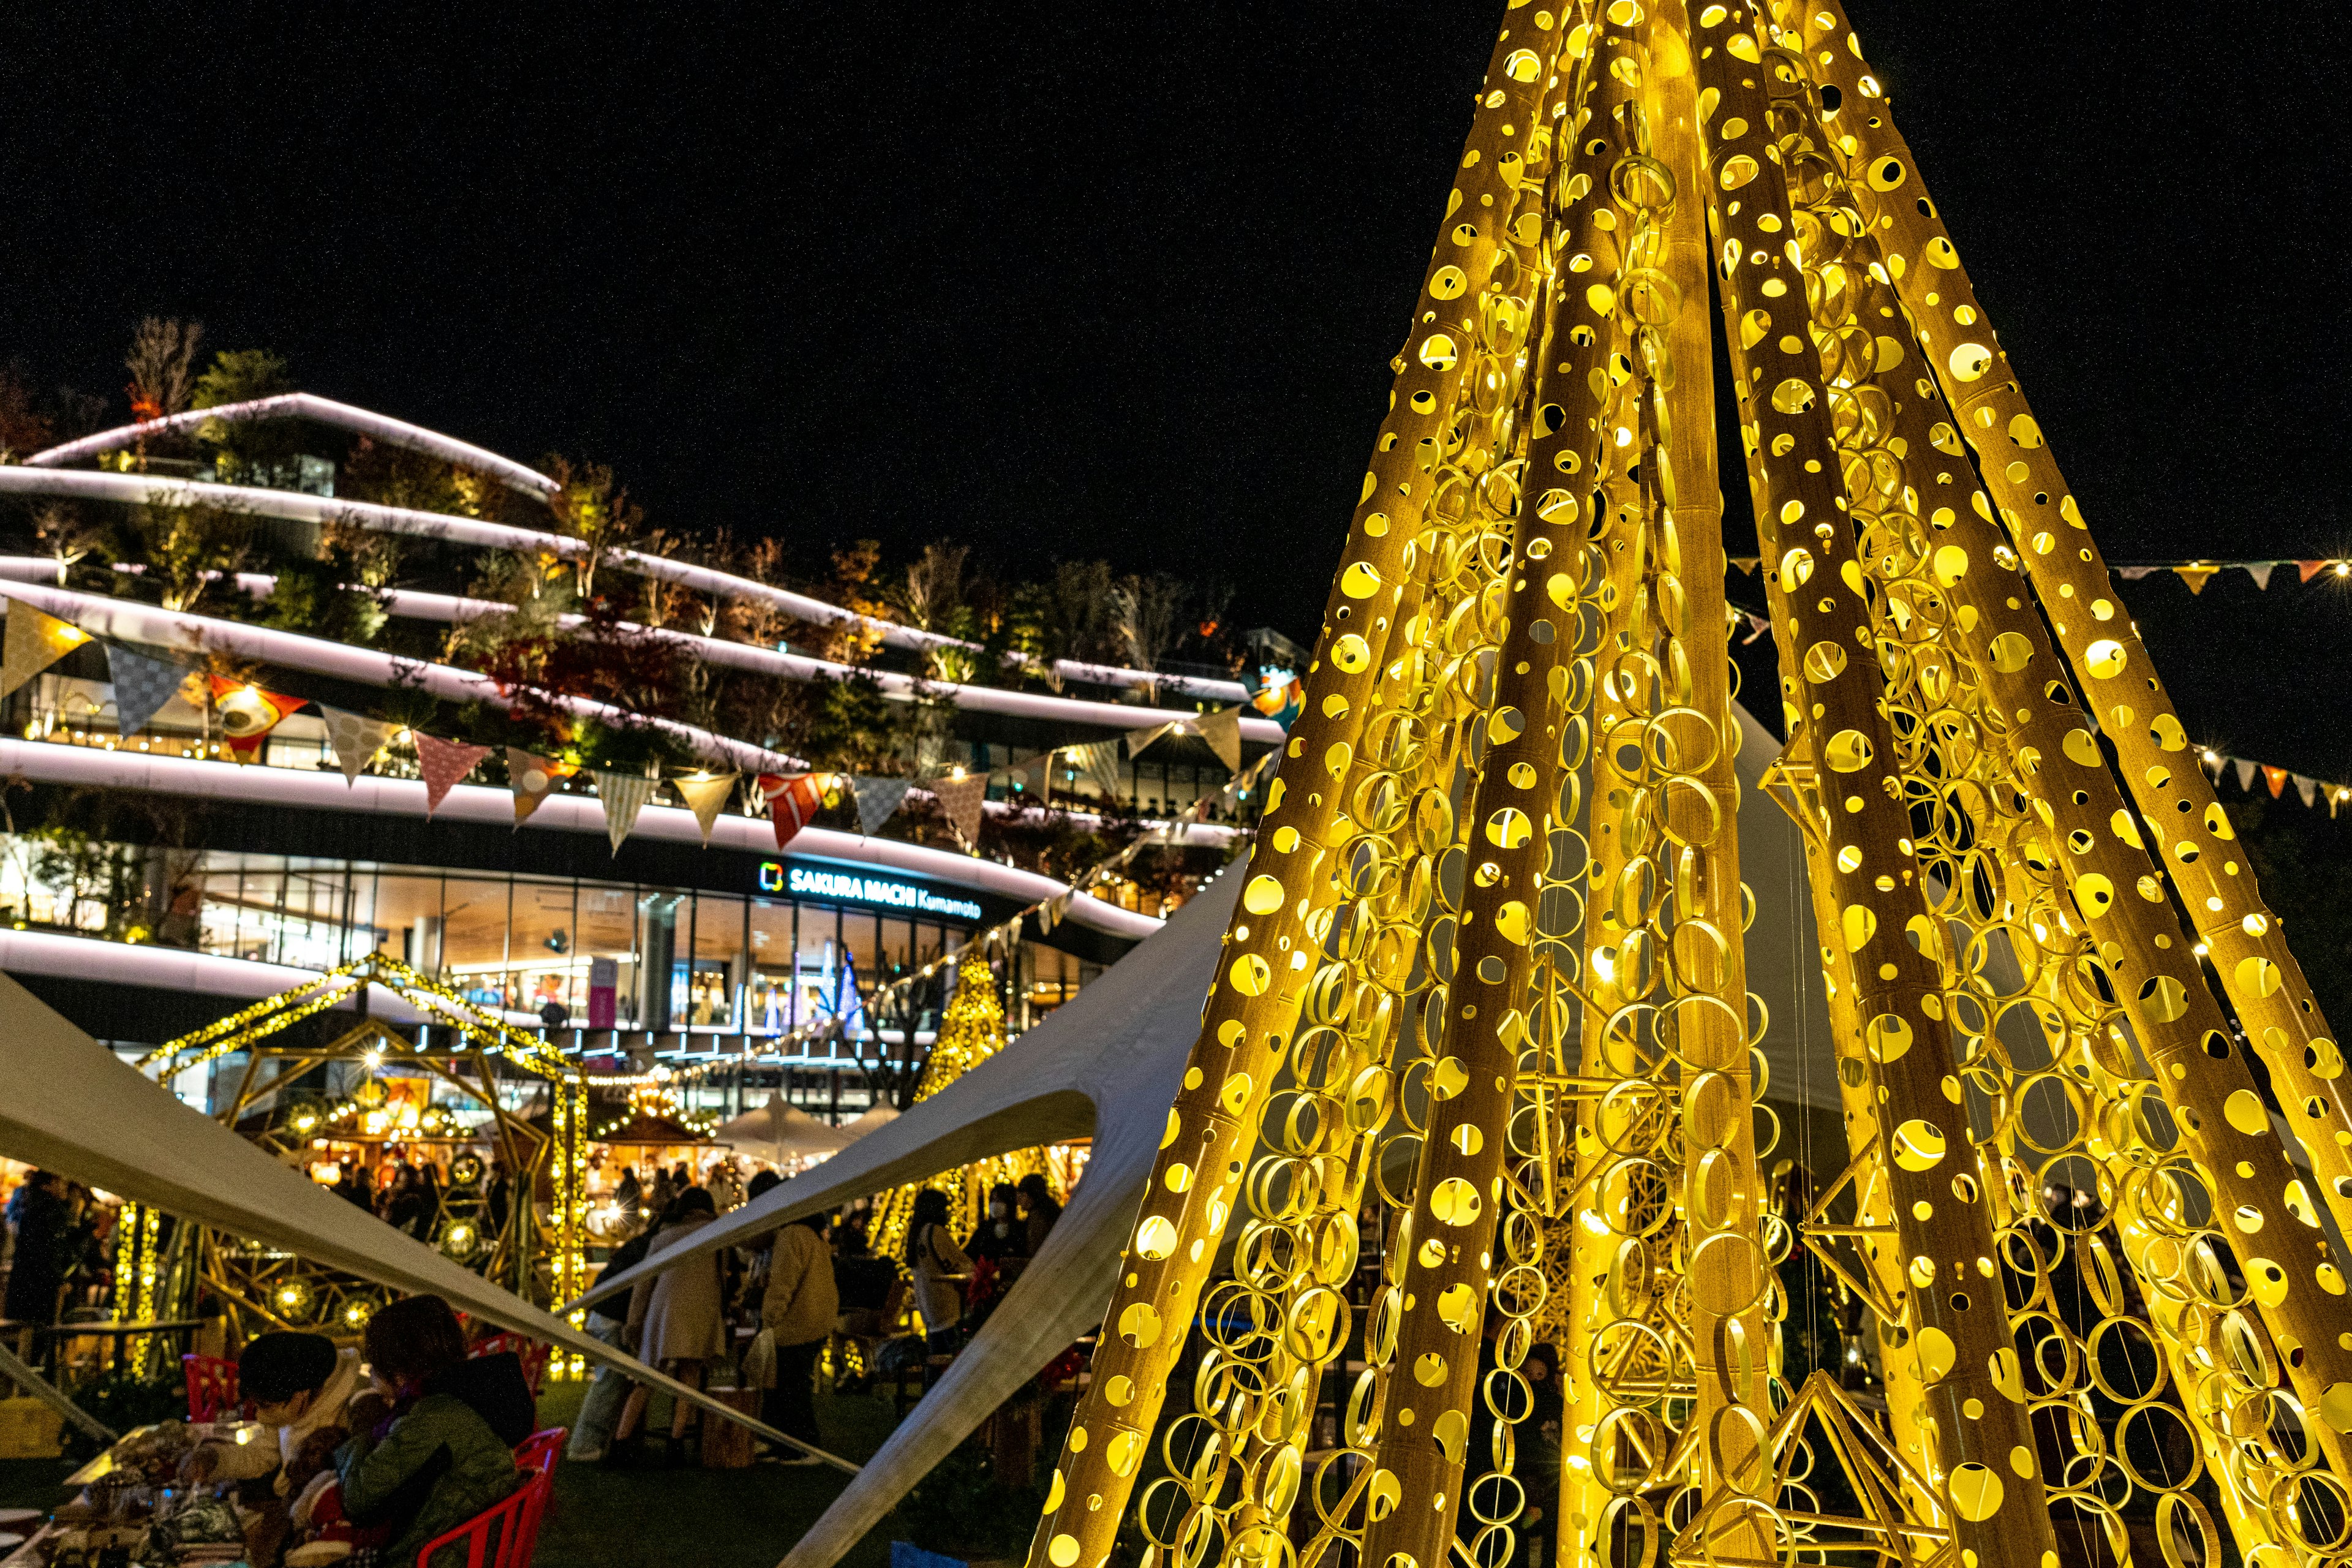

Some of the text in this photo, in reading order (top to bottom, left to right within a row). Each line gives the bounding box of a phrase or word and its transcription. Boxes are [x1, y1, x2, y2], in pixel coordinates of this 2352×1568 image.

[790, 869, 981, 919] SAKURA MACHI Kumamoto
